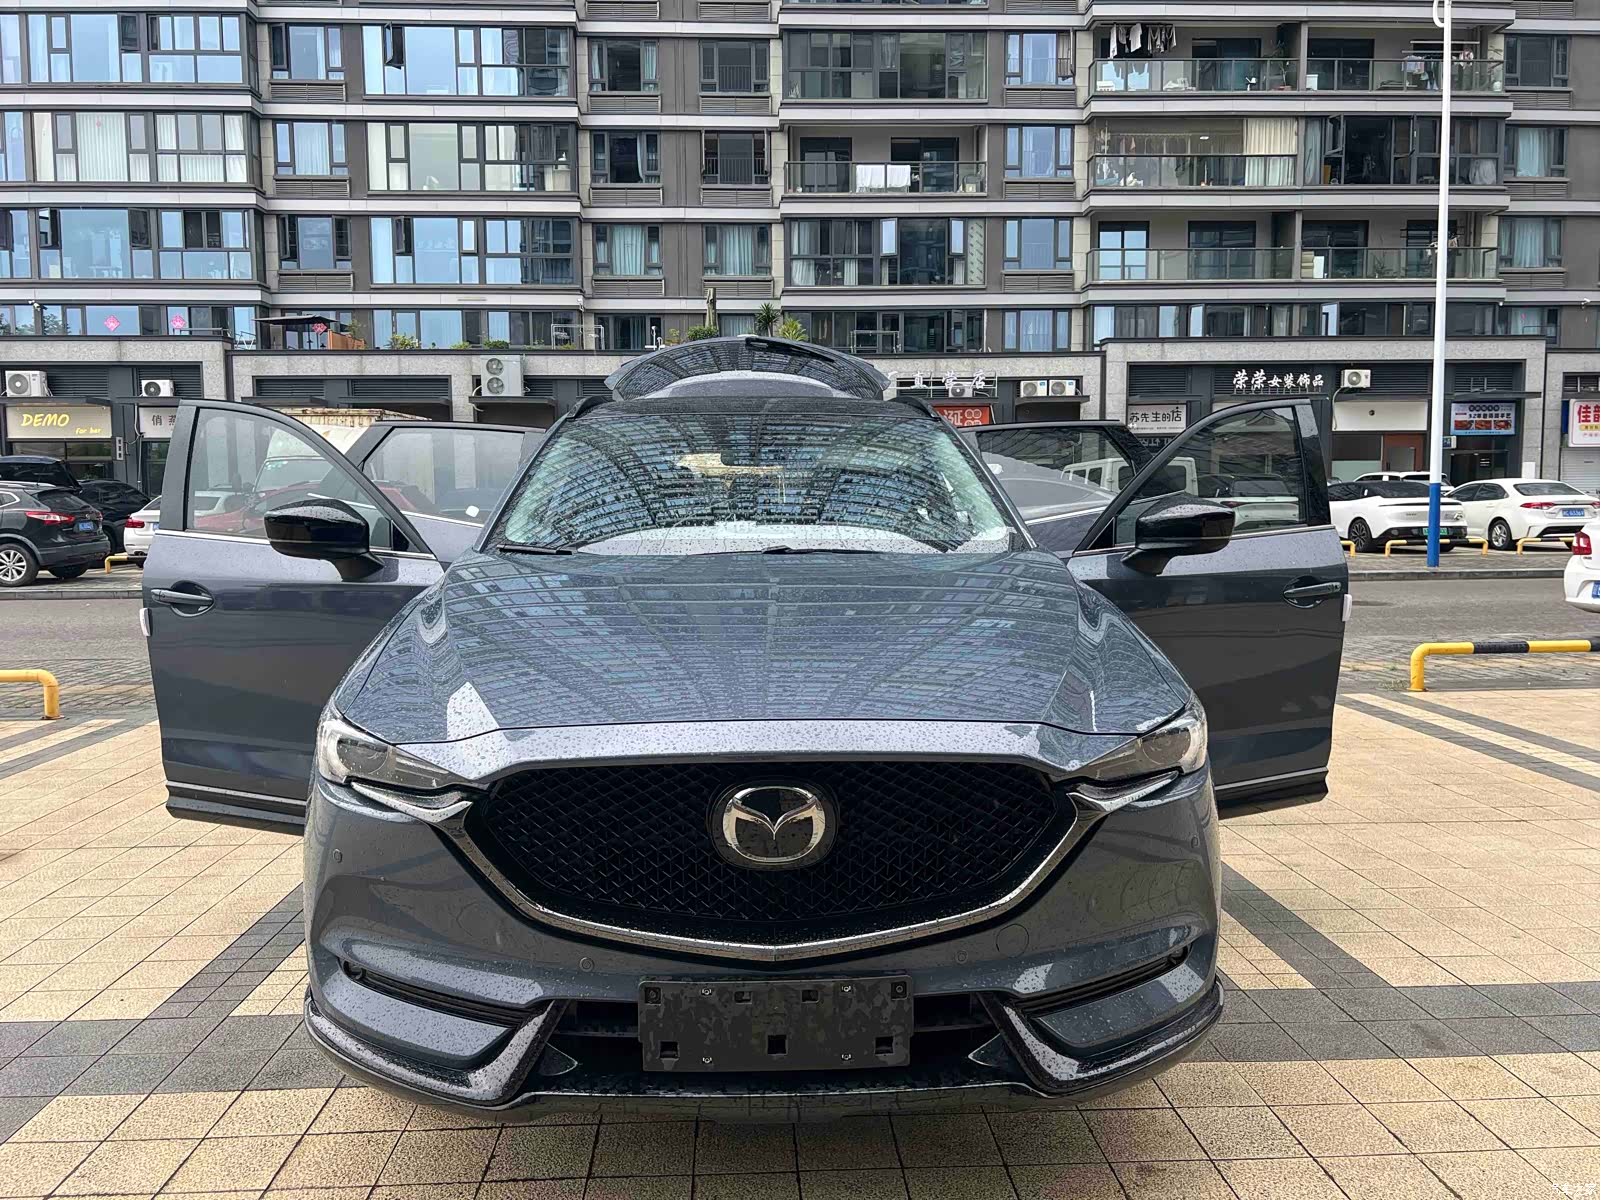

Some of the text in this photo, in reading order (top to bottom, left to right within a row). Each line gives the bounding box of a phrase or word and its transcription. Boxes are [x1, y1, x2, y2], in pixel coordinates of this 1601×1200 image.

[1232, 368, 1325, 389] 荣荣女装饰品
[20, 412, 70, 427] DEMO
[1129, 406, 1183, 423] 苏先生的店
